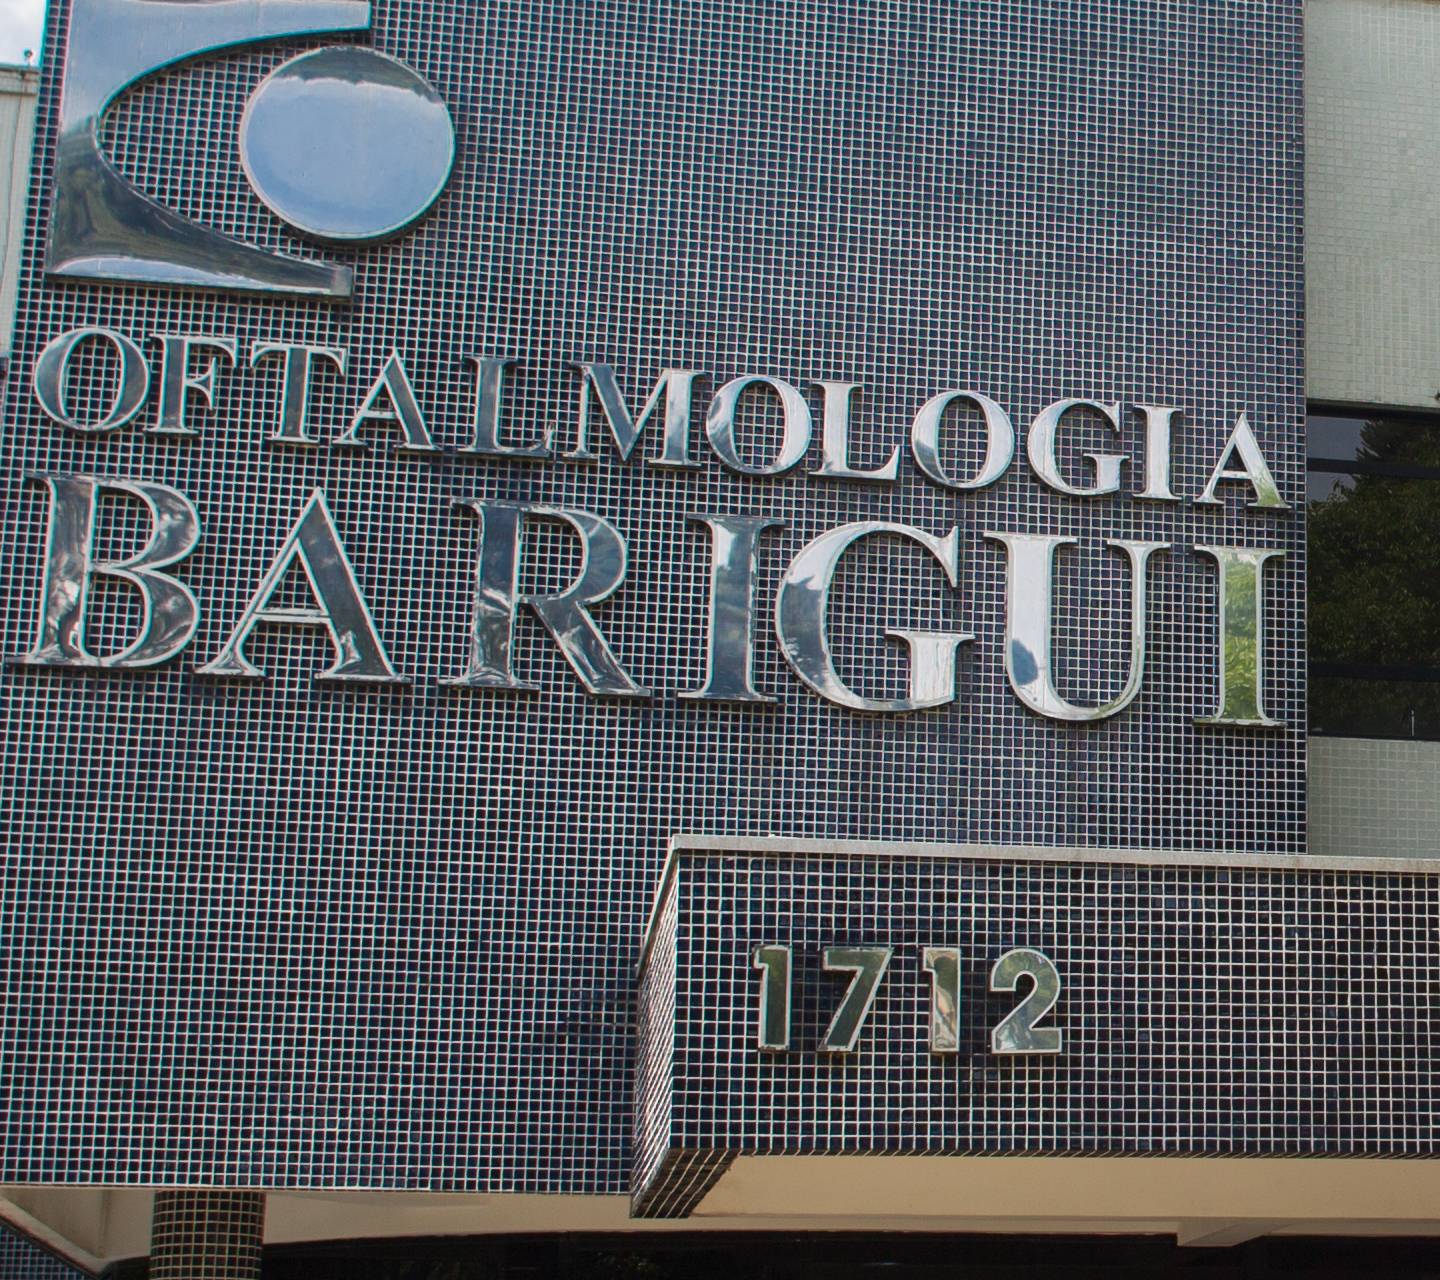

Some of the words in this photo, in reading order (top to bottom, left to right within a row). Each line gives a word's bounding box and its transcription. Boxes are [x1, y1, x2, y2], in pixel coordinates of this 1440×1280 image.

[32, 326, 1293, 510] OFTALMOLOGIA
[5, 471, 1287, 730] BARIGUI
[754, 943, 1062, 1055] 1712
